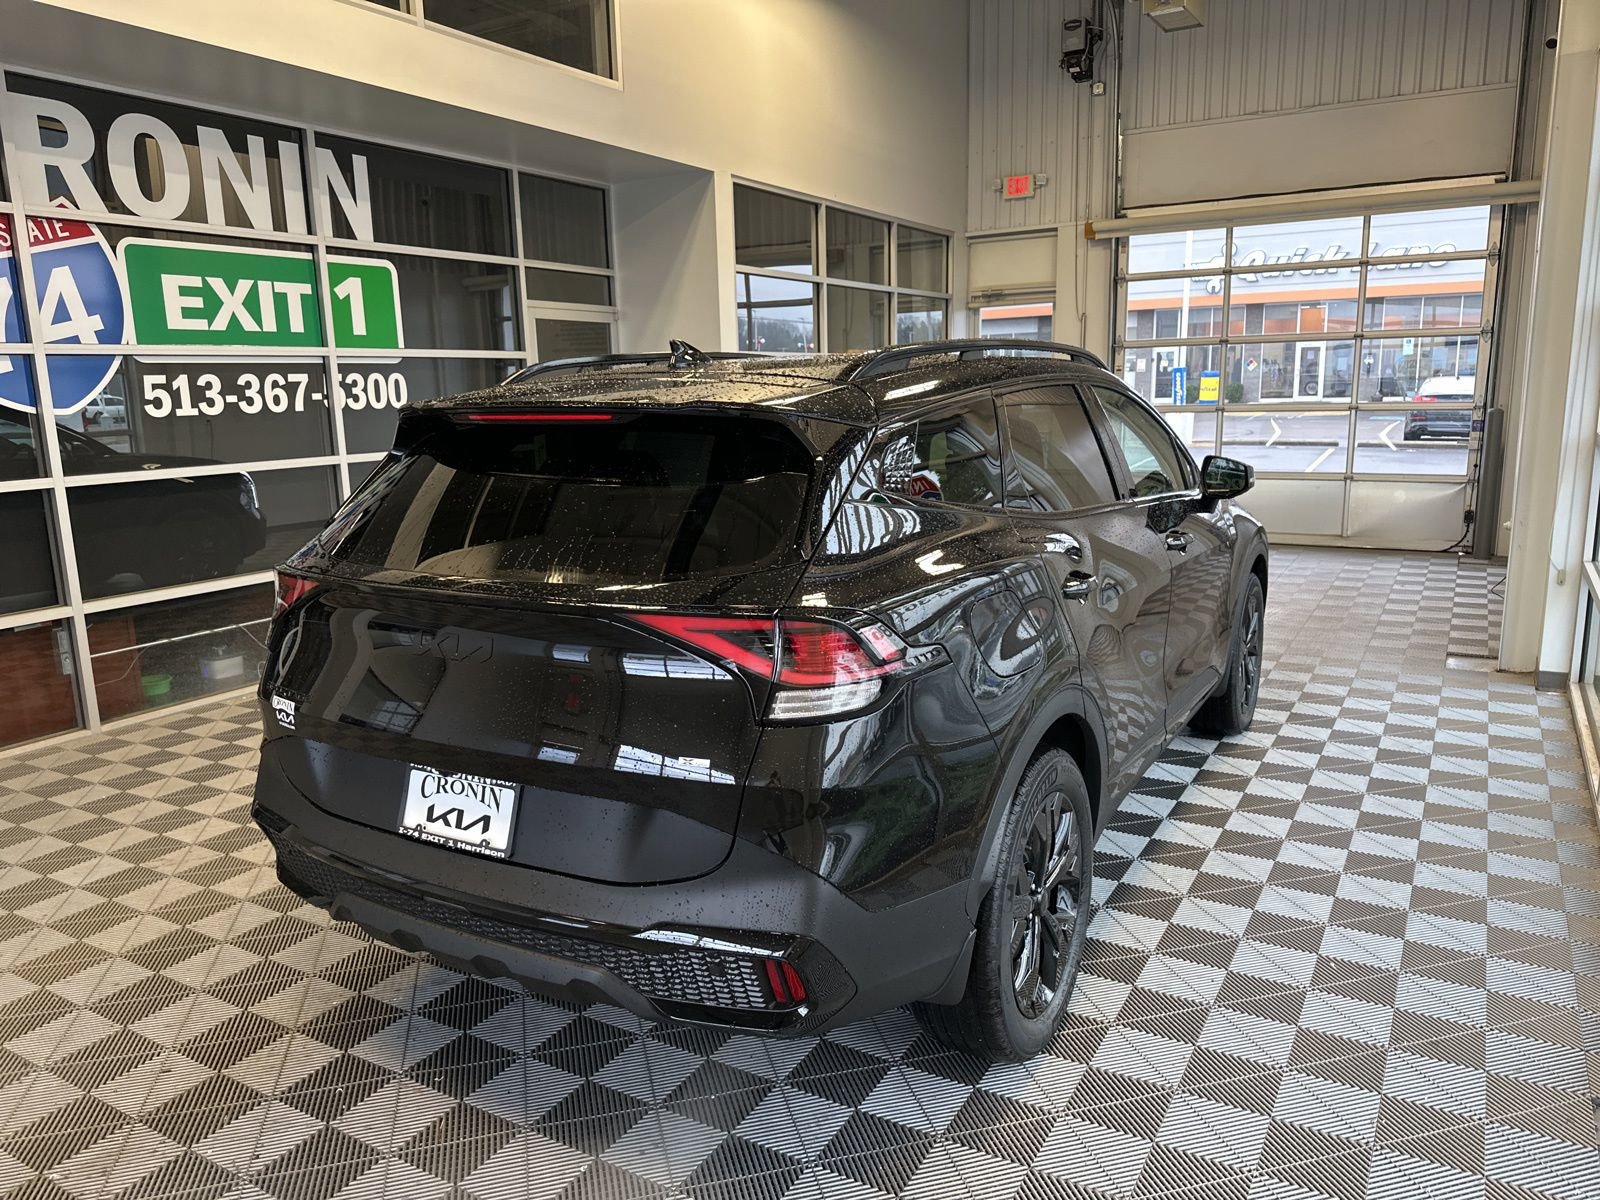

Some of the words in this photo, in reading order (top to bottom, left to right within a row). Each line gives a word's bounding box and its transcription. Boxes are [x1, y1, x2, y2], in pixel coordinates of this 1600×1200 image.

[161, 274, 312, 333] EXIT
[333, 276, 367, 336] 1
[421, 774, 503, 814] CRONIN
[398, 826, 420, 838] I-74
[421, 833, 446, 845] EXIT
[447, 840, 455, 848] 1
[457, 841, 505, 858] Harrison
